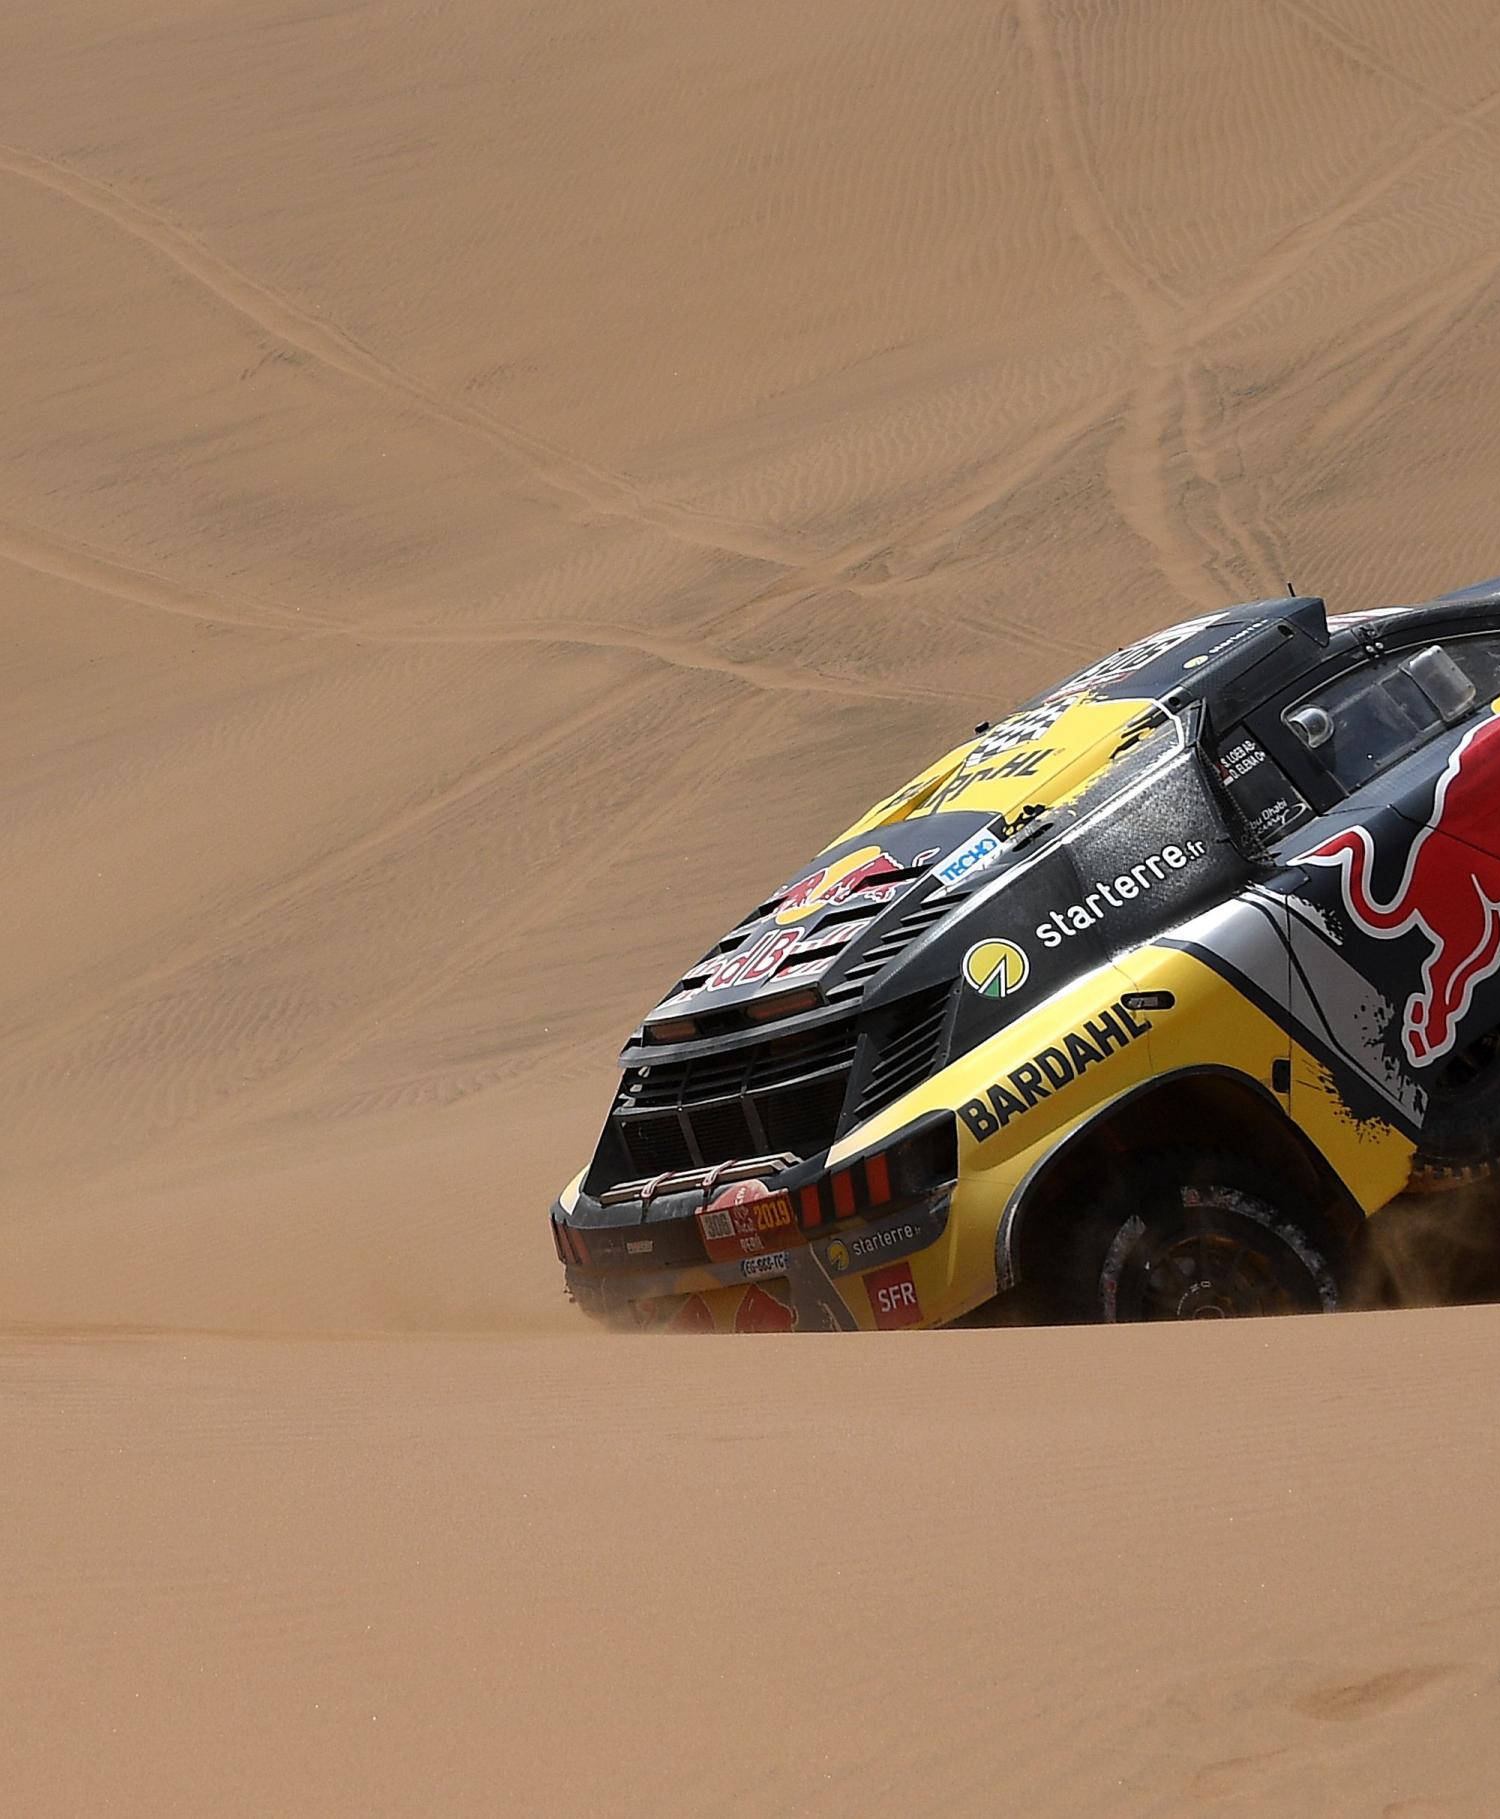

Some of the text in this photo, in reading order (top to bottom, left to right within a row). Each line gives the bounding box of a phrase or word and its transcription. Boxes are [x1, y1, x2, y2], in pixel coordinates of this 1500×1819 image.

[1226, 746, 1247, 763] LOEB
[1235, 754, 1260, 774] ELENA
[1261, 797, 1288, 821] Dhabi
[940, 838, 997, 881] TECHO
[956, 1002, 1153, 1143] BARDAHL
[753, 1199, 791, 1231] 2019
[878, 1282, 916, 1312] SFR
